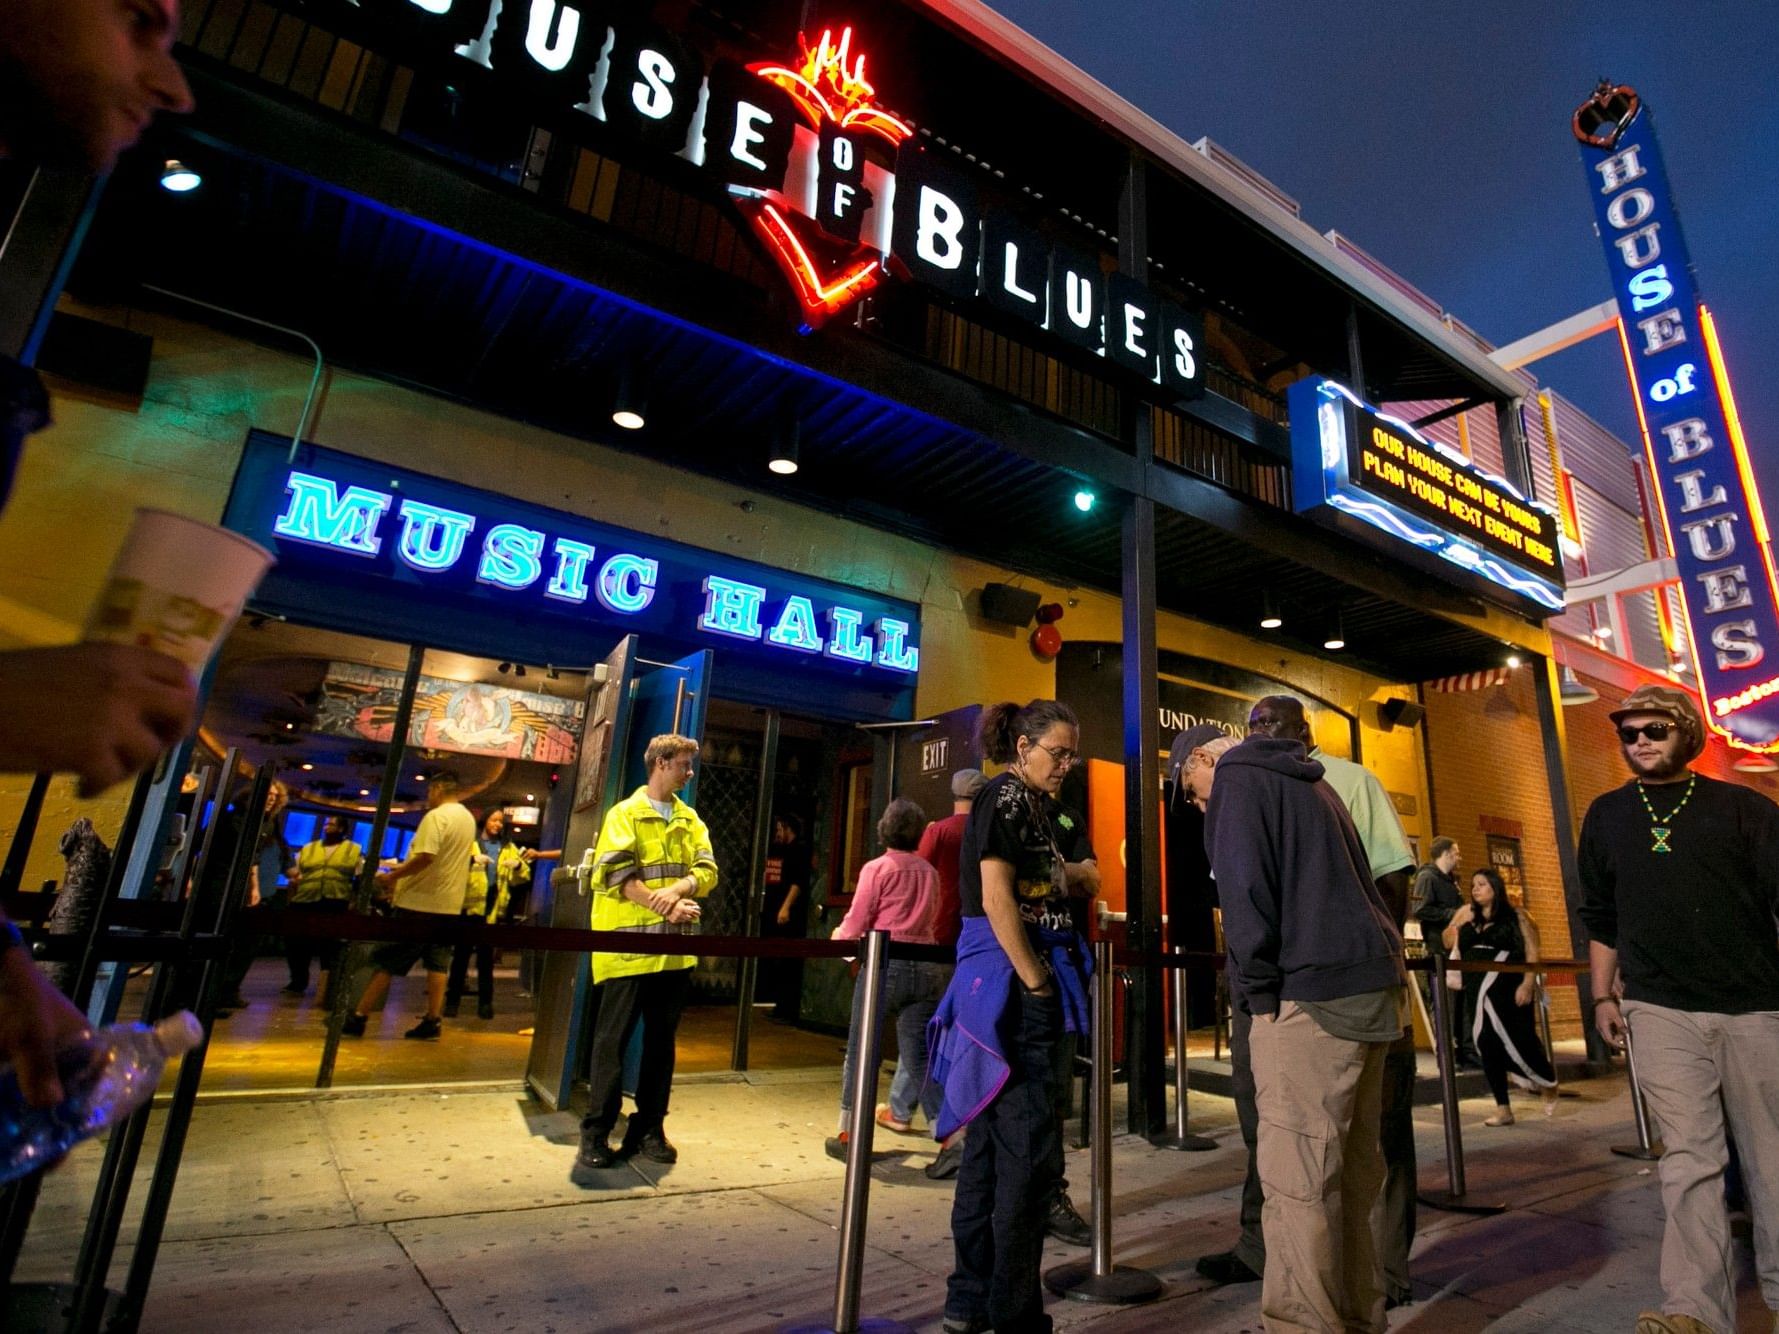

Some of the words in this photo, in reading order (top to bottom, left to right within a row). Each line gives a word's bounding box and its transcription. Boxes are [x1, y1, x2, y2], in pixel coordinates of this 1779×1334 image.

[408, 0, 773, 171] USE
[833, 136, 856, 217] OF
[916, 184, 1196, 379] BLUES
[1595, 143, 1687, 356] HOUSE
[1650, 362, 1696, 402] of
[1363, 450, 1405, 488] PLAN
[1407, 473, 1446, 510] YOUR
[1448, 495, 1482, 528] NEXT
[1484, 514, 1523, 549] EVENT
[1373, 427, 1405, 460] OUR
[1407, 445, 1453, 487] HOUSE
[1455, 473, 1482, 503] CAN
[1483, 488, 1501, 513] BE
[1501, 498, 1541, 534] YOURS
[1661, 417, 1764, 672] BLUES
[272, 471, 659, 614] MUSIC
[697, 574, 919, 673] HALL
[923, 740, 947, 770] EXIT
